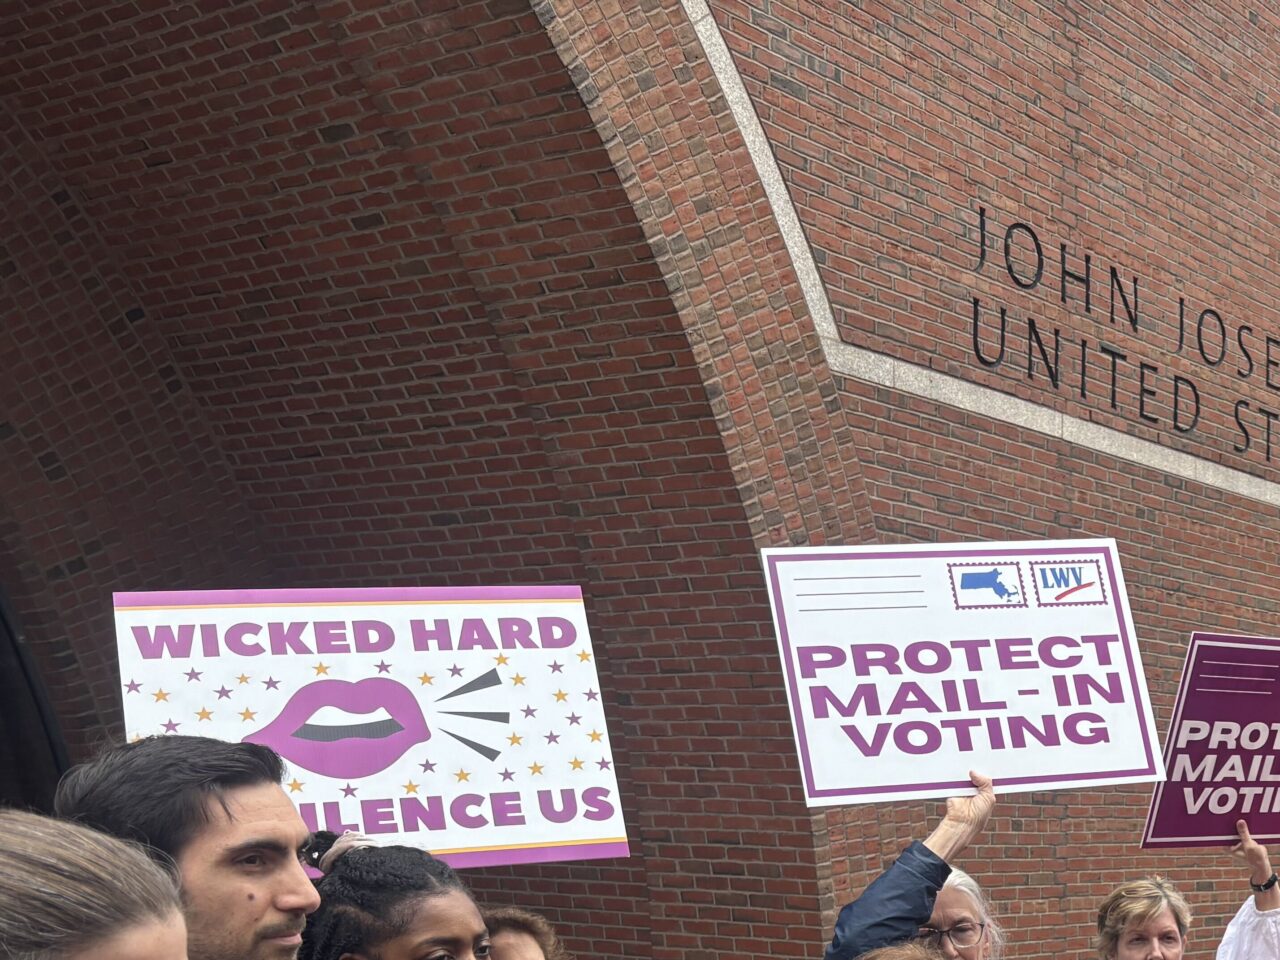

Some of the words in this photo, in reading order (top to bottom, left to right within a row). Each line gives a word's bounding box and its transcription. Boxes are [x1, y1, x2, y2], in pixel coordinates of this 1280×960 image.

[971, 206, 1139, 334] JOHN
[971, 297, 1201, 434] UNITED
[1039, 566, 1085, 589] LWV
[130, 619, 396, 660] WICKED
[409, 616, 578, 652] HARD
[796, 633, 1120, 679] PROTECT
[840, 711, 1111, 758] VOTING
[299, 791, 527, 835] ILENCE
[537, 786, 616, 824] US
